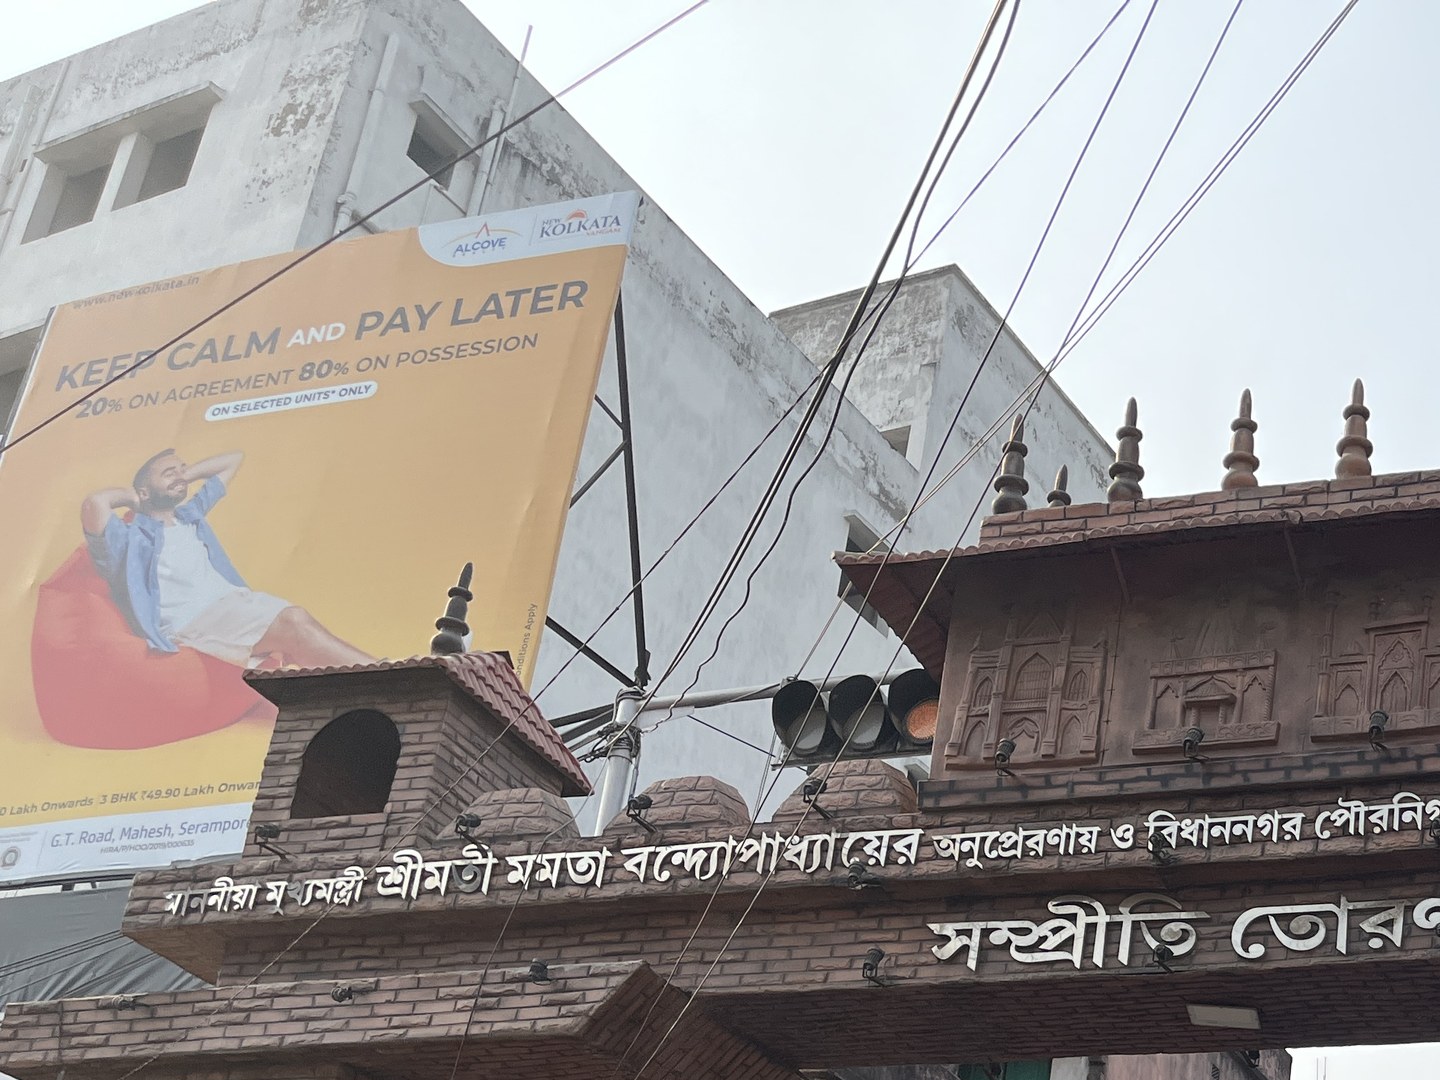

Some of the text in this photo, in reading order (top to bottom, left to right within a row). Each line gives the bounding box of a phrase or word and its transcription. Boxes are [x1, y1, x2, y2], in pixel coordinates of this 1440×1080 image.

[454, 237, 508, 254] ALCOVE
[539, 215, 621, 239] KOLKATA
[55, 280, 589, 392] KEEP CALM AND PAY LATER
[75, 333, 538, 418] 20% ON AGREEMENT 80% ON POSSESSION
[211, 407, 229, 417] ON
[232, 396, 292, 414] SELECTED
[339, 384, 373, 398] ONLY
[515, 603, 538, 676] onditions Apply
[10, 803, 38, 816] Lakh
[41, 796, 94, 812] Onwards
[99, 794, 107, 805] 3
[110, 791, 137, 804] BHK
[183, 784, 215, 797] Lakh
[218, 781, 261, 793] Onwar
[50, 832, 75, 848] G.T.
[79, 830, 115, 846] Road,
[119, 824, 175, 842] Mahesh,
[376, 843, 498, 900] শ্রীমতী
[506, 846, 611, 892] মমতা
[621, 826, 925, 884] বন্দ্যোপাধ্যায়ের
[932, 822, 1101, 871] অনুপ্রেরণায়
[1110, 823, 1135, 850] ও
[1144, 809, 1305, 852] বিধাননগর
[926, 893, 1210, 972] সম্প্রীতি
